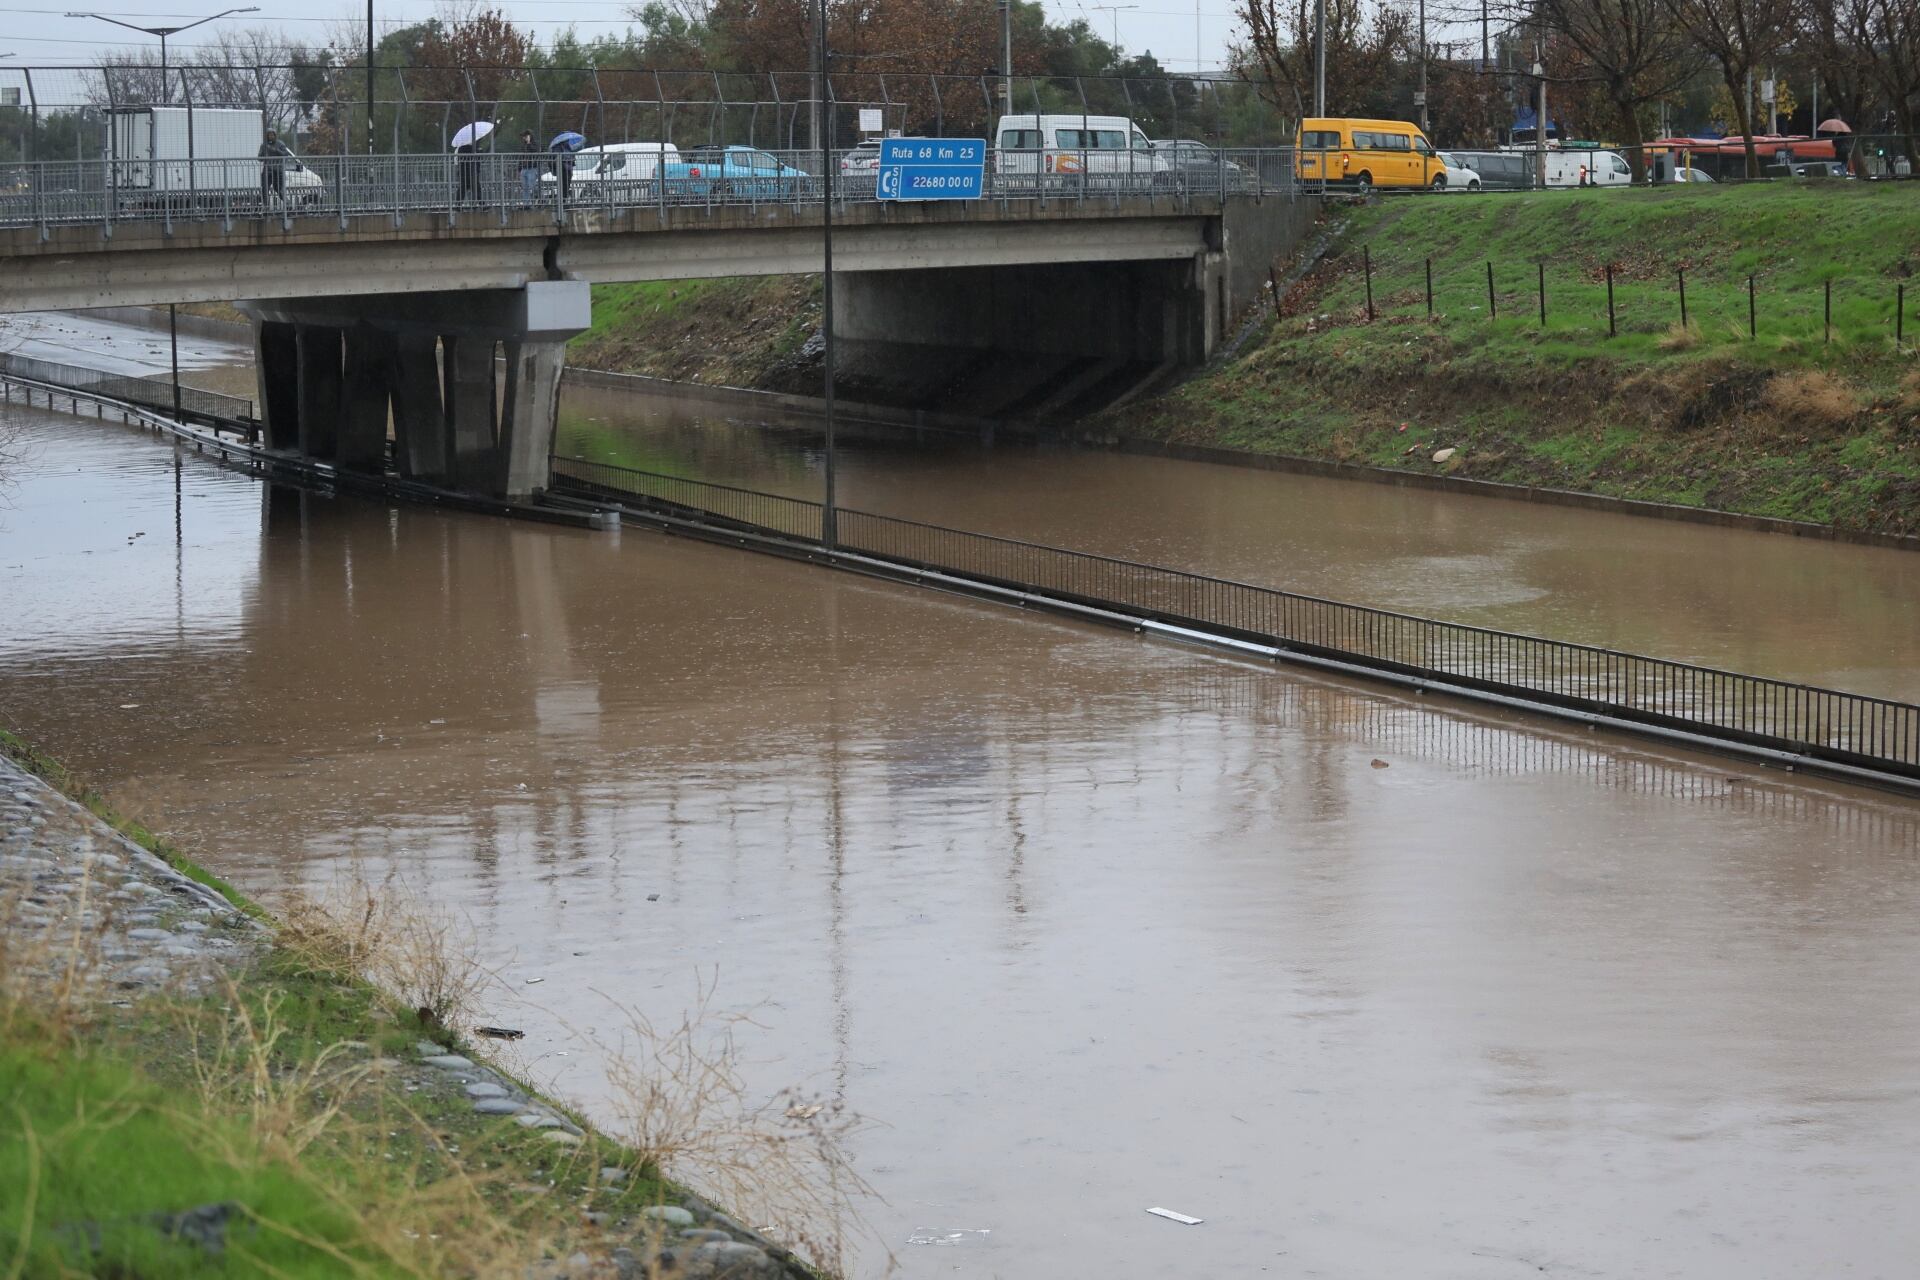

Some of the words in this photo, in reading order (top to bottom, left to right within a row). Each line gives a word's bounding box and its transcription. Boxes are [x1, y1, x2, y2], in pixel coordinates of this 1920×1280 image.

[892, 148, 913, 159] Ruta
[919, 148, 932, 159] 68
[938, 147, 953, 159] Km
[890, 167, 899, 197] SOS
[912, 176, 945, 188] 22680
[948, 176, 960, 188] 00
[963, 176, 973, 188] 01
